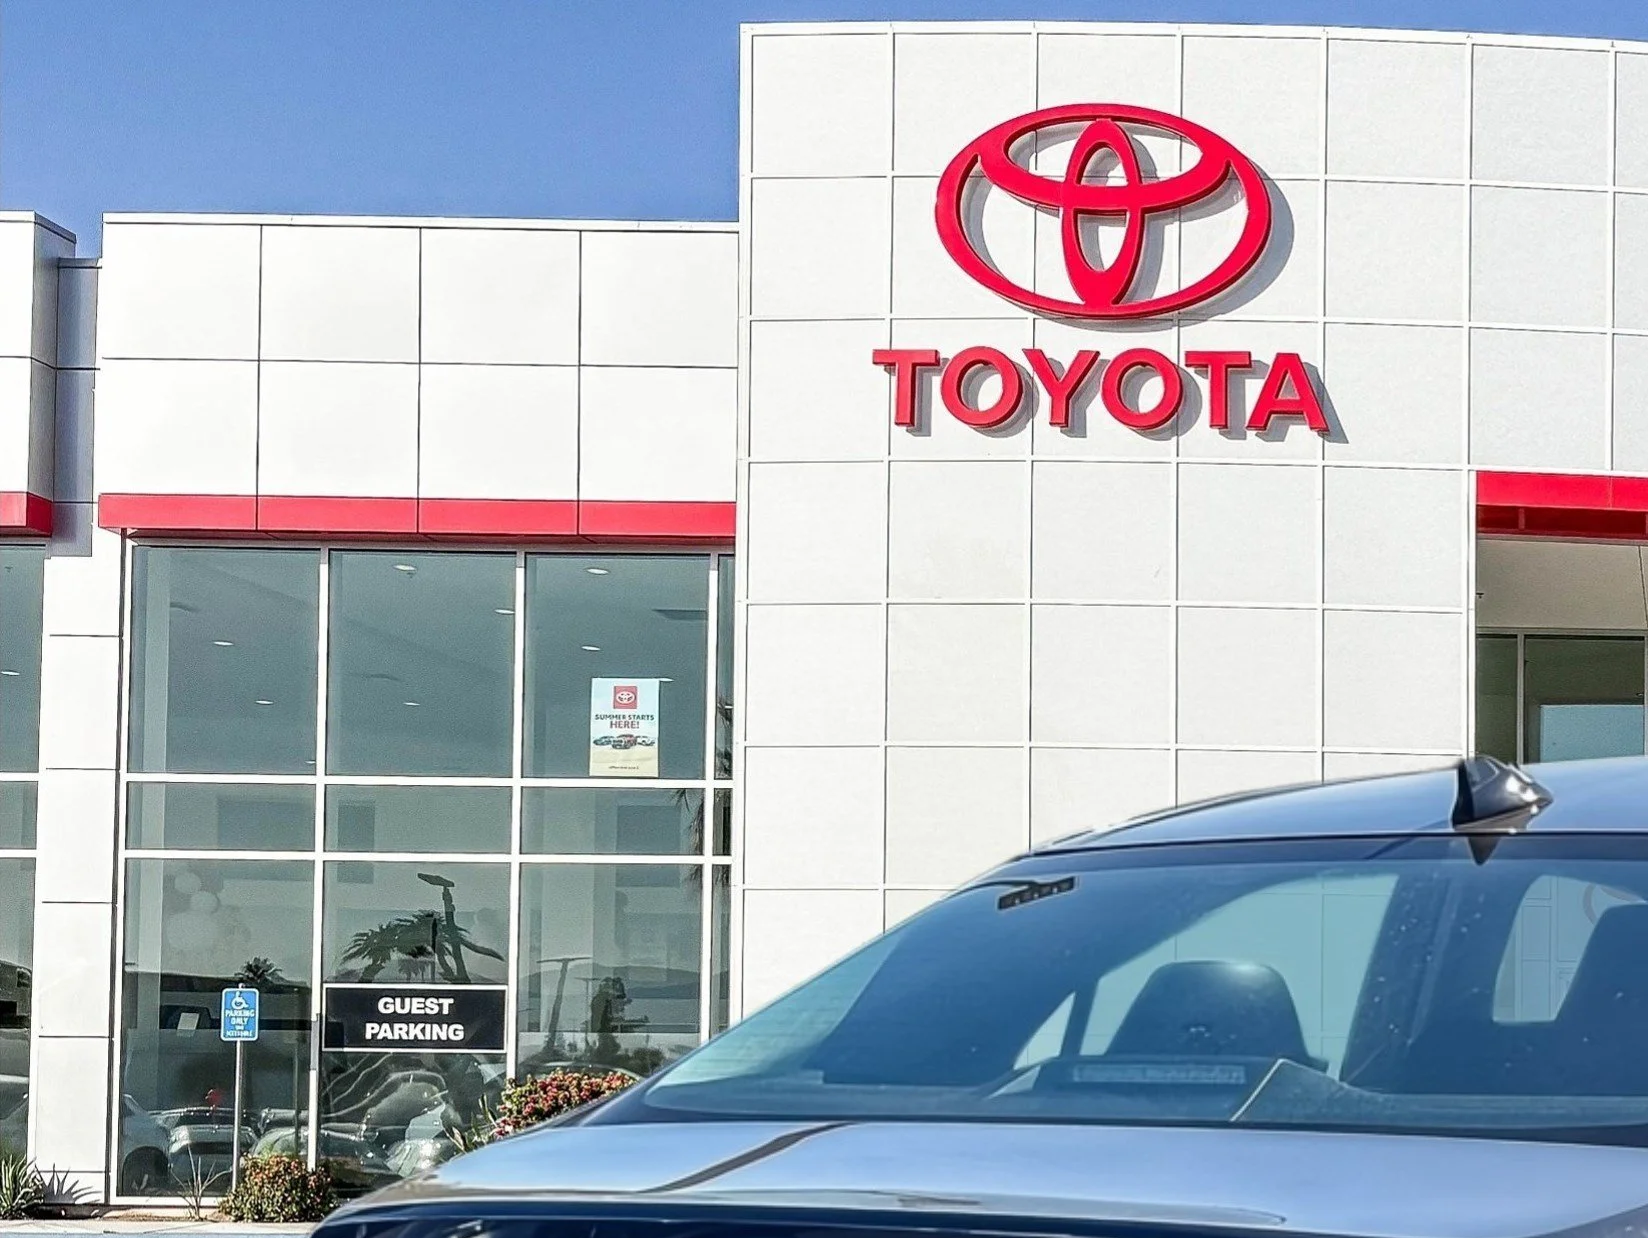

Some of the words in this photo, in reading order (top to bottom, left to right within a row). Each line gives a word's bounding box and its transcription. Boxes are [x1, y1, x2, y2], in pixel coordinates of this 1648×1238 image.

[873, 346, 1330, 434] TOYOTA
[610, 721, 640, 729] HERE!
[377, 997, 454, 1015] GUEST
[365, 1022, 465, 1041] PARKING
